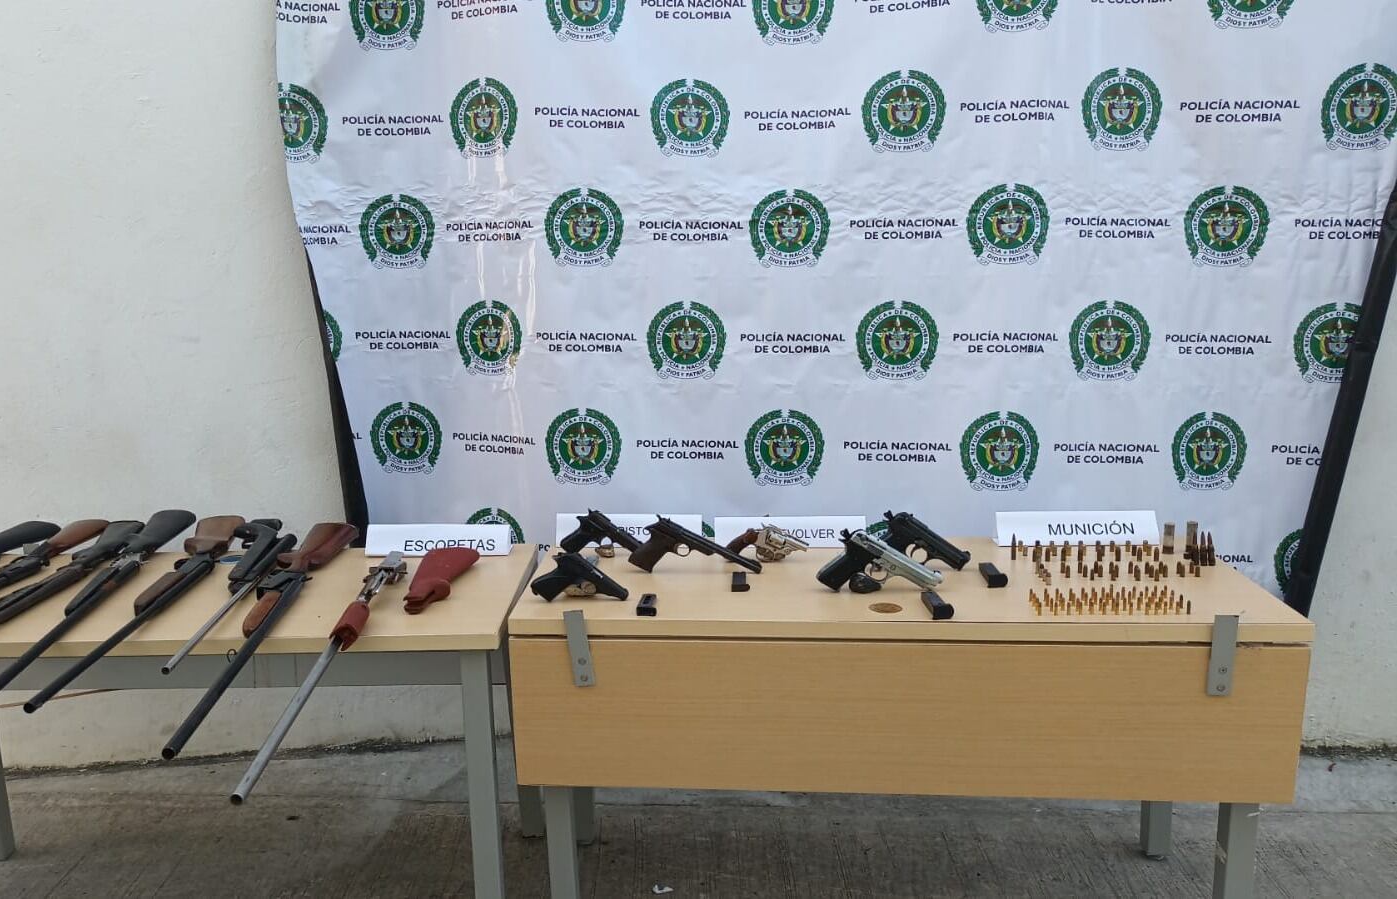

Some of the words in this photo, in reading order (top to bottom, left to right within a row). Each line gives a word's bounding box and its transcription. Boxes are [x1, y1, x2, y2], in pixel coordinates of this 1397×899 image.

[285, 2, 340, 12] NACIONAL
[870, 5, 884, 13] DE
[452, 11, 463, 20] DE
[466, 5, 517, 18] COLOMBIA
[673, 11, 731, 19] COLOMBIA
[960, 101, 1006, 111] POLICÍA
[1010, 99, 1069, 109] NACIONAL
[1180, 100, 1231, 111] POLICÍA
[1234, 100, 1301, 110] NACIONAL
[535, 106, 578, 116] POLICÍA
[582, 109, 640, 117] NACIONAL
[745, 109, 788, 119] POLICÍA
[791, 108, 851, 118] NACIONAL
[343, 114, 385, 124] POLICÍA
[388, 115, 444, 124] NACIONAL
[975, 115, 990, 123] DE
[994, 112, 1054, 122] COLOMBIA
[1216, 113, 1281, 122] COLOMBIA
[567, 120, 625, 128] COLOMBIA
[759, 123, 772, 131] DE
[776, 121, 835, 130] COLOMBIA
[358, 128, 371, 136] DE
[375, 127, 430, 136] COLOMBIA
[446, 221, 483, 231] POLICÍA
[485, 220, 533, 230] NACIONAL
[639, 220, 682, 229] POLICÍA
[686, 221, 743, 229] NACIONAL
[850, 218, 894, 228] POLICÍA
[898, 219, 958, 227] NACIONAL
[1065, 216, 1107, 226] POLICÍA
[1110, 218, 1170, 226] NACIONAL
[1295, 217, 1342, 227] POLICÍA
[304, 225, 351, 233] NACIONAL
[458, 234, 470, 242] DE
[473, 233, 521, 241] COLOMBIA
[670, 233, 728, 241] COLOMBIA
[882, 231, 942, 239] COLOMBIA
[1079, 230, 1092, 238] DE
[1095, 230, 1154, 238] COLOMBIA
[1309, 231, 1324, 239] DE
[356, 330, 397, 339] POLICÍA
[537, 332, 576, 340] POLICÍA
[580, 333, 636, 341] NACIONAL
[741, 332, 784, 341] POLICÍA
[953, 331, 999, 341] POLICÍA
[1003, 333, 1058, 341] NACIONAL
[1166, 333, 1207, 342] POLICÍA
[1210, 335, 1271, 343] NACIONAL
[565, 344, 622, 352] COLOMBIA
[755, 345, 768, 353] DE
[772, 345, 830, 353] COLOMBIA
[987, 345, 1044, 353] COLOMBIA
[1179, 346, 1192, 354] DE
[1195, 346, 1254, 355] COLOMBIA
[453, 432, 489, 441] POLICÍA
[492, 434, 535, 445] NACIONAL
[637, 438, 678, 447] POLICÍA
[682, 440, 739, 448] NACIONAL
[479, 445, 524, 455] COLOMBIA
[844, 440, 888, 449] POLICÍA
[892, 443, 951, 451] NACIONAL
[1054, 442, 1095, 451] POLICÍA
[1099, 444, 1159, 452] NACIONAL
[1272, 445, 1320, 454] POLICÍA
[651, 451, 664, 459] DE
[667, 451, 724, 459] COLOMBIA
[858, 453, 872, 461] DE
[876, 454, 936, 462] COLOMBIA
[1084, 456, 1143, 464] COLOMBIA
[1286, 457, 1302, 465] DE
[1048, 520, 1135, 536] MUNICIÓN
